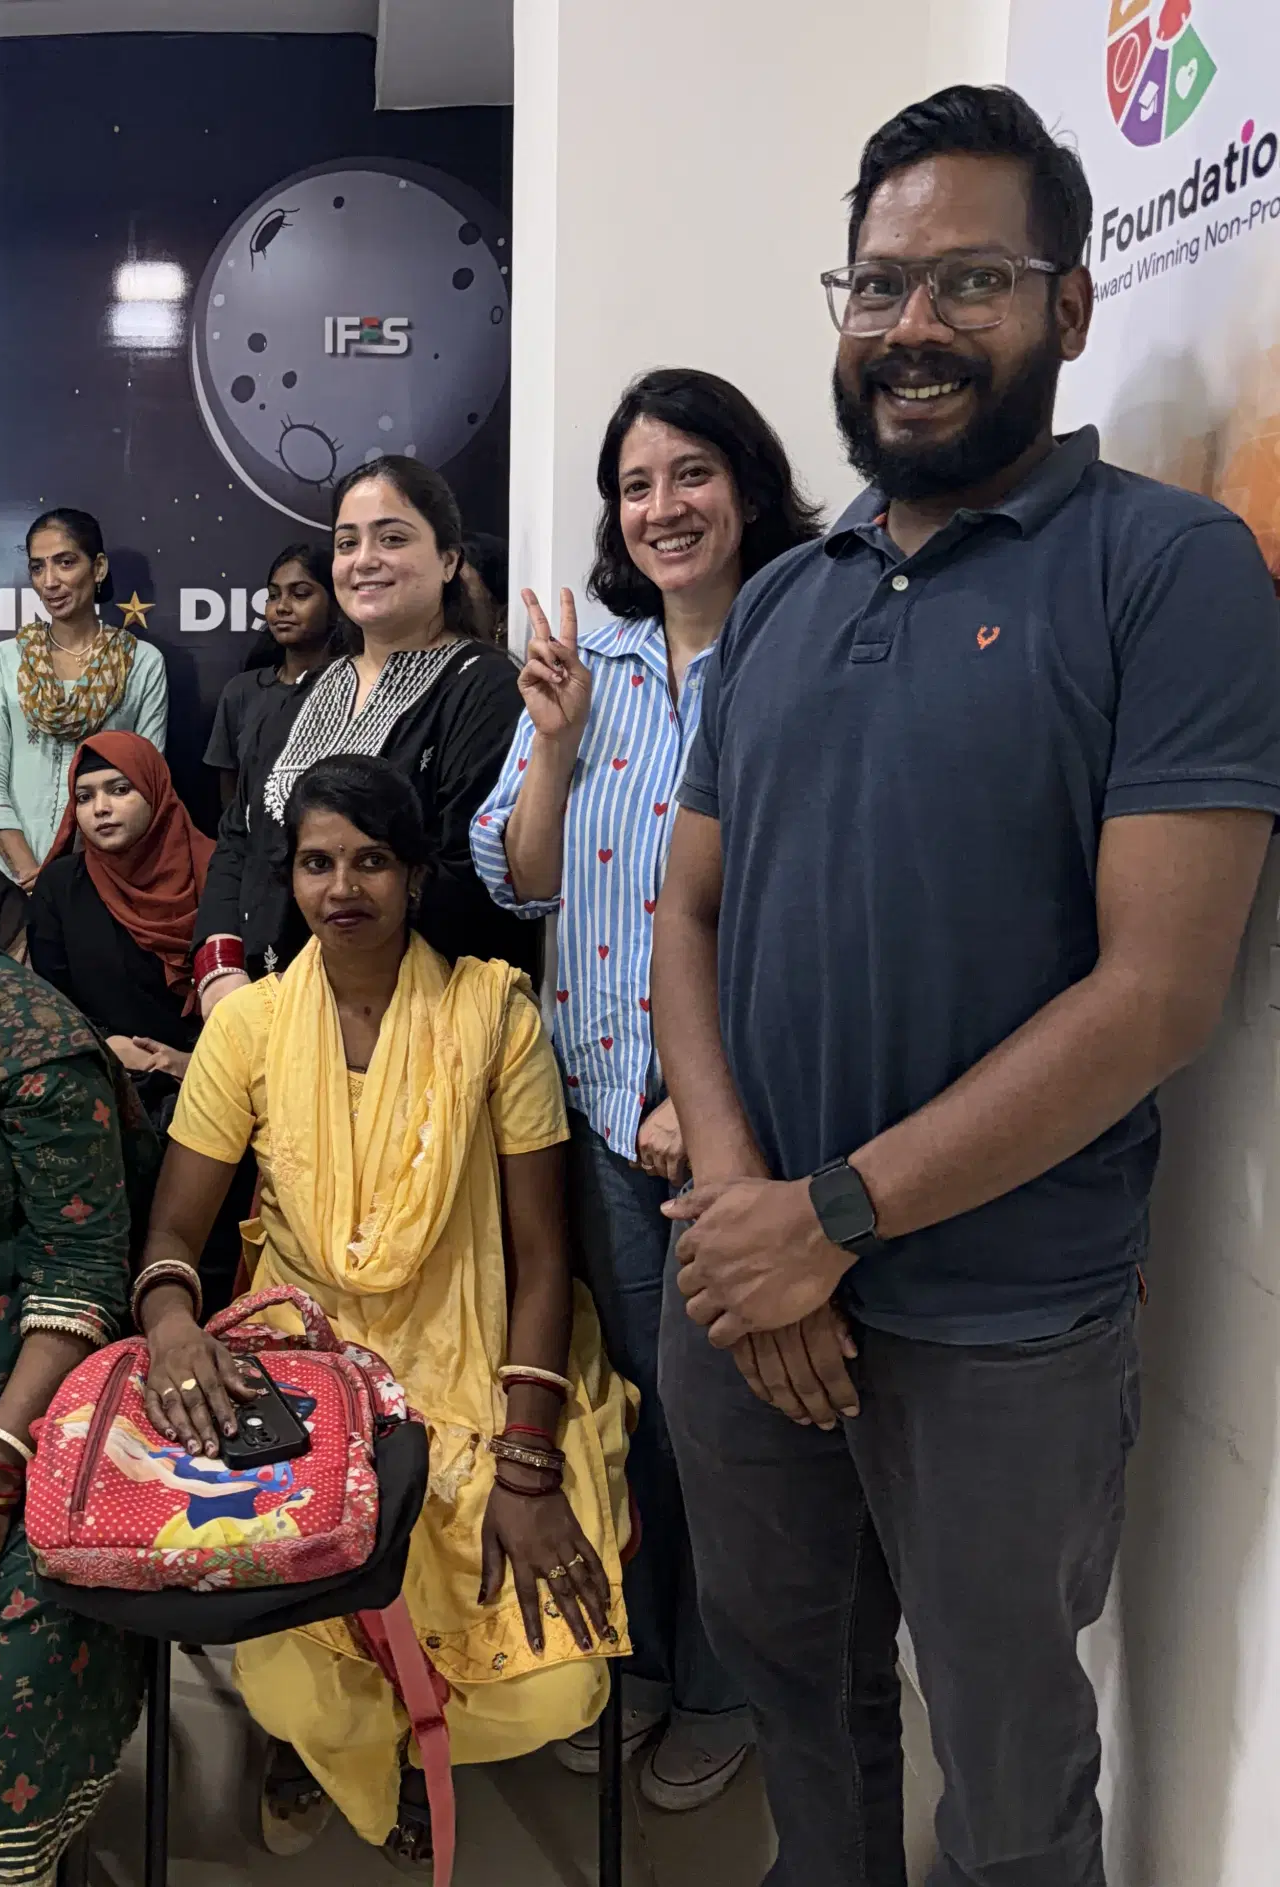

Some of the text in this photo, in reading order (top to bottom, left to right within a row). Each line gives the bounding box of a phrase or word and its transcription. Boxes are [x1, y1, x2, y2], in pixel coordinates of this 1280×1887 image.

[1100, 118, 1280, 263] Foundatio
[1093, 264, 1133, 303] Award
[1137, 237, 1200, 283] Winning
